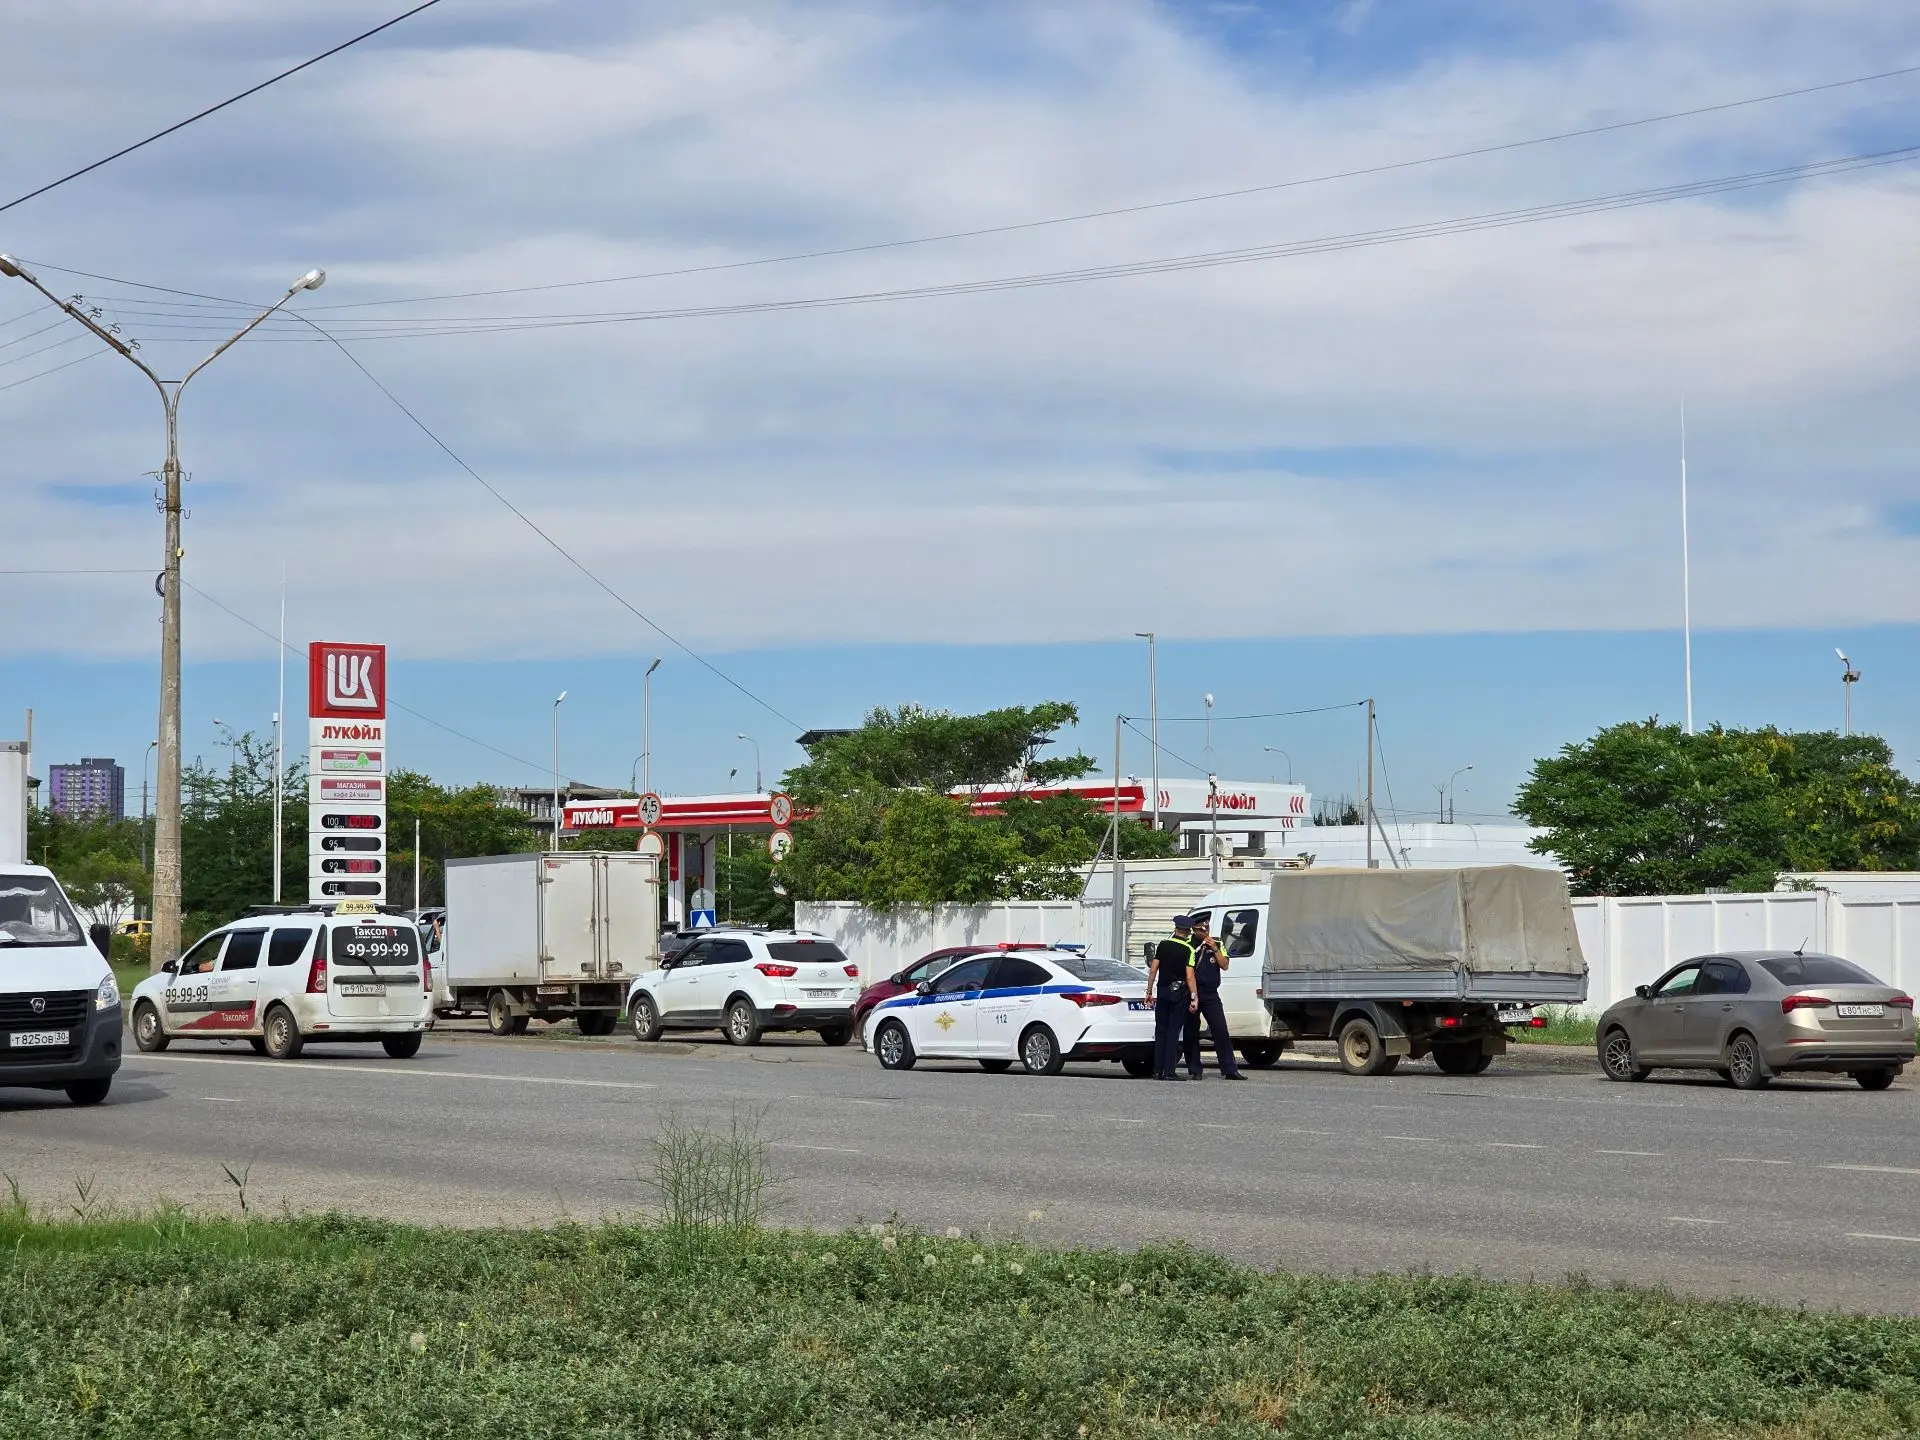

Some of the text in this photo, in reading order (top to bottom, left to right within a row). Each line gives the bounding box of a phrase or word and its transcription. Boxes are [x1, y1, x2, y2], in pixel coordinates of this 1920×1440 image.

[321, 724, 382, 740] ЛУКОЙЛ
[1205, 792, 1256, 810] ЛУКОЙЛ
[571, 807, 614, 825] ЛУКОЙЛ
[327, 817, 340, 826] 100
[328, 840, 339, 849] 95
[328, 861, 339, 870] 92
[328, 883, 340, 893] ДТ
[345, 903, 374, 912] 99-99-99
[346, 943, 409, 957] 99-99-99
[165, 985, 208, 1003] 99-99-99
[934, 993, 966, 1003] ПОЛИЦИЯ
[995, 1014, 1008, 1024] 112
